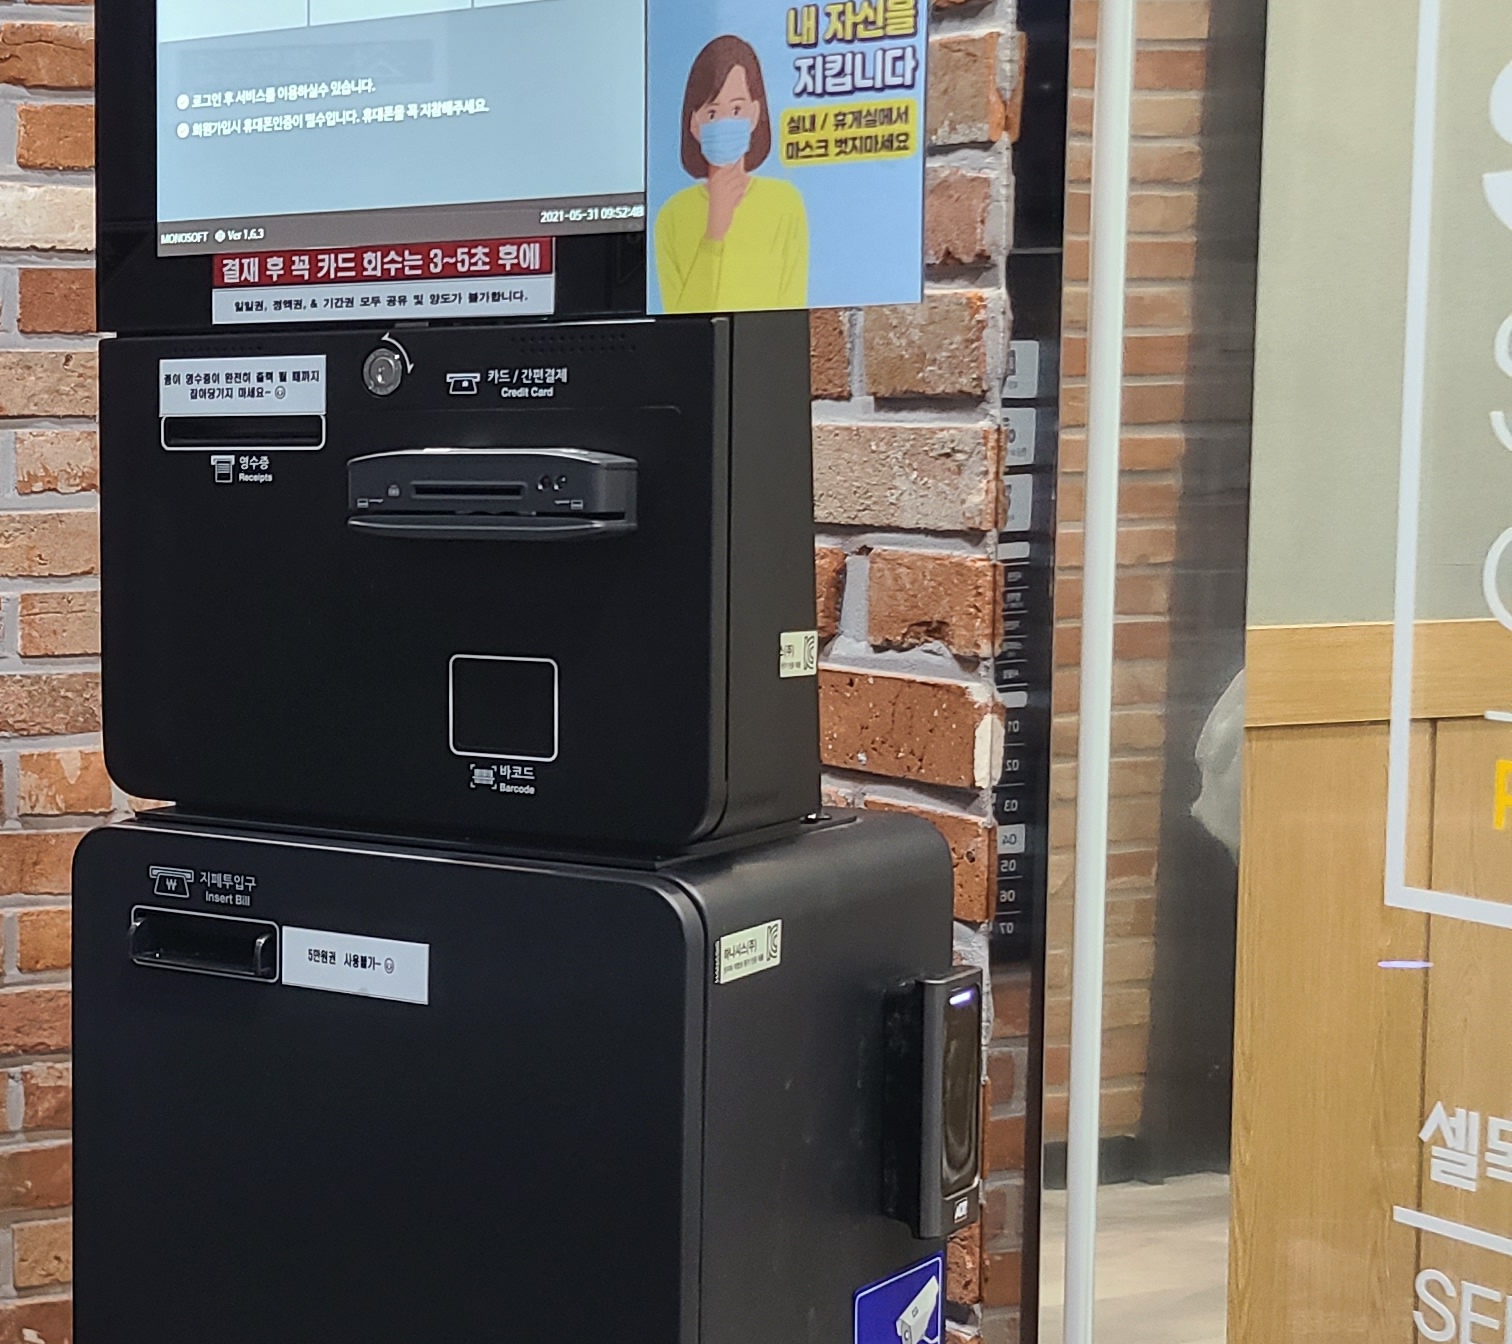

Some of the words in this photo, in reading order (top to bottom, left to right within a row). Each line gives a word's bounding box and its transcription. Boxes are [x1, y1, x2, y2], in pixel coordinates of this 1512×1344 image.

[786, 3, 817, 47] 내
[793, 45, 919, 97] 지킵니다
[191, 91, 223, 109] 로그인
[223, 90, 235, 107] 후
[235, 87, 275, 105] 서비스를
[787, 115, 816, 134] 실내
[833, 104, 910, 130] 휴게실에서
[785, 139, 829, 160] 마스크
[834, 132, 910, 156] 벗지마세요
[221, 256, 259, 284] 결재
[265, 256, 285, 281] 후
[291, 255, 311, 281] 꼭
[316, 253, 357, 279] 카드
[362, 251, 423, 277] 회수는
[429, 247, 491, 275] 3~5초
[497, 243, 541, 270] 후에
[323, 296, 355, 310] 기간권
[487, 369, 510, 383] 카드
[521, 367, 568, 384] 간편결제
[501, 387, 528, 398] Credit
[530, 386, 553, 397] Card
[239, 456, 270, 471] 영수증
[238, 472, 273, 484] Receipts
[498, 764, 536, 782] 바코드
[498, 783, 536, 796] Barcode
[199, 870, 257, 892] 지폐투입구
[205, 890, 233, 905] Insert
[235, 894, 251, 907] Bill
